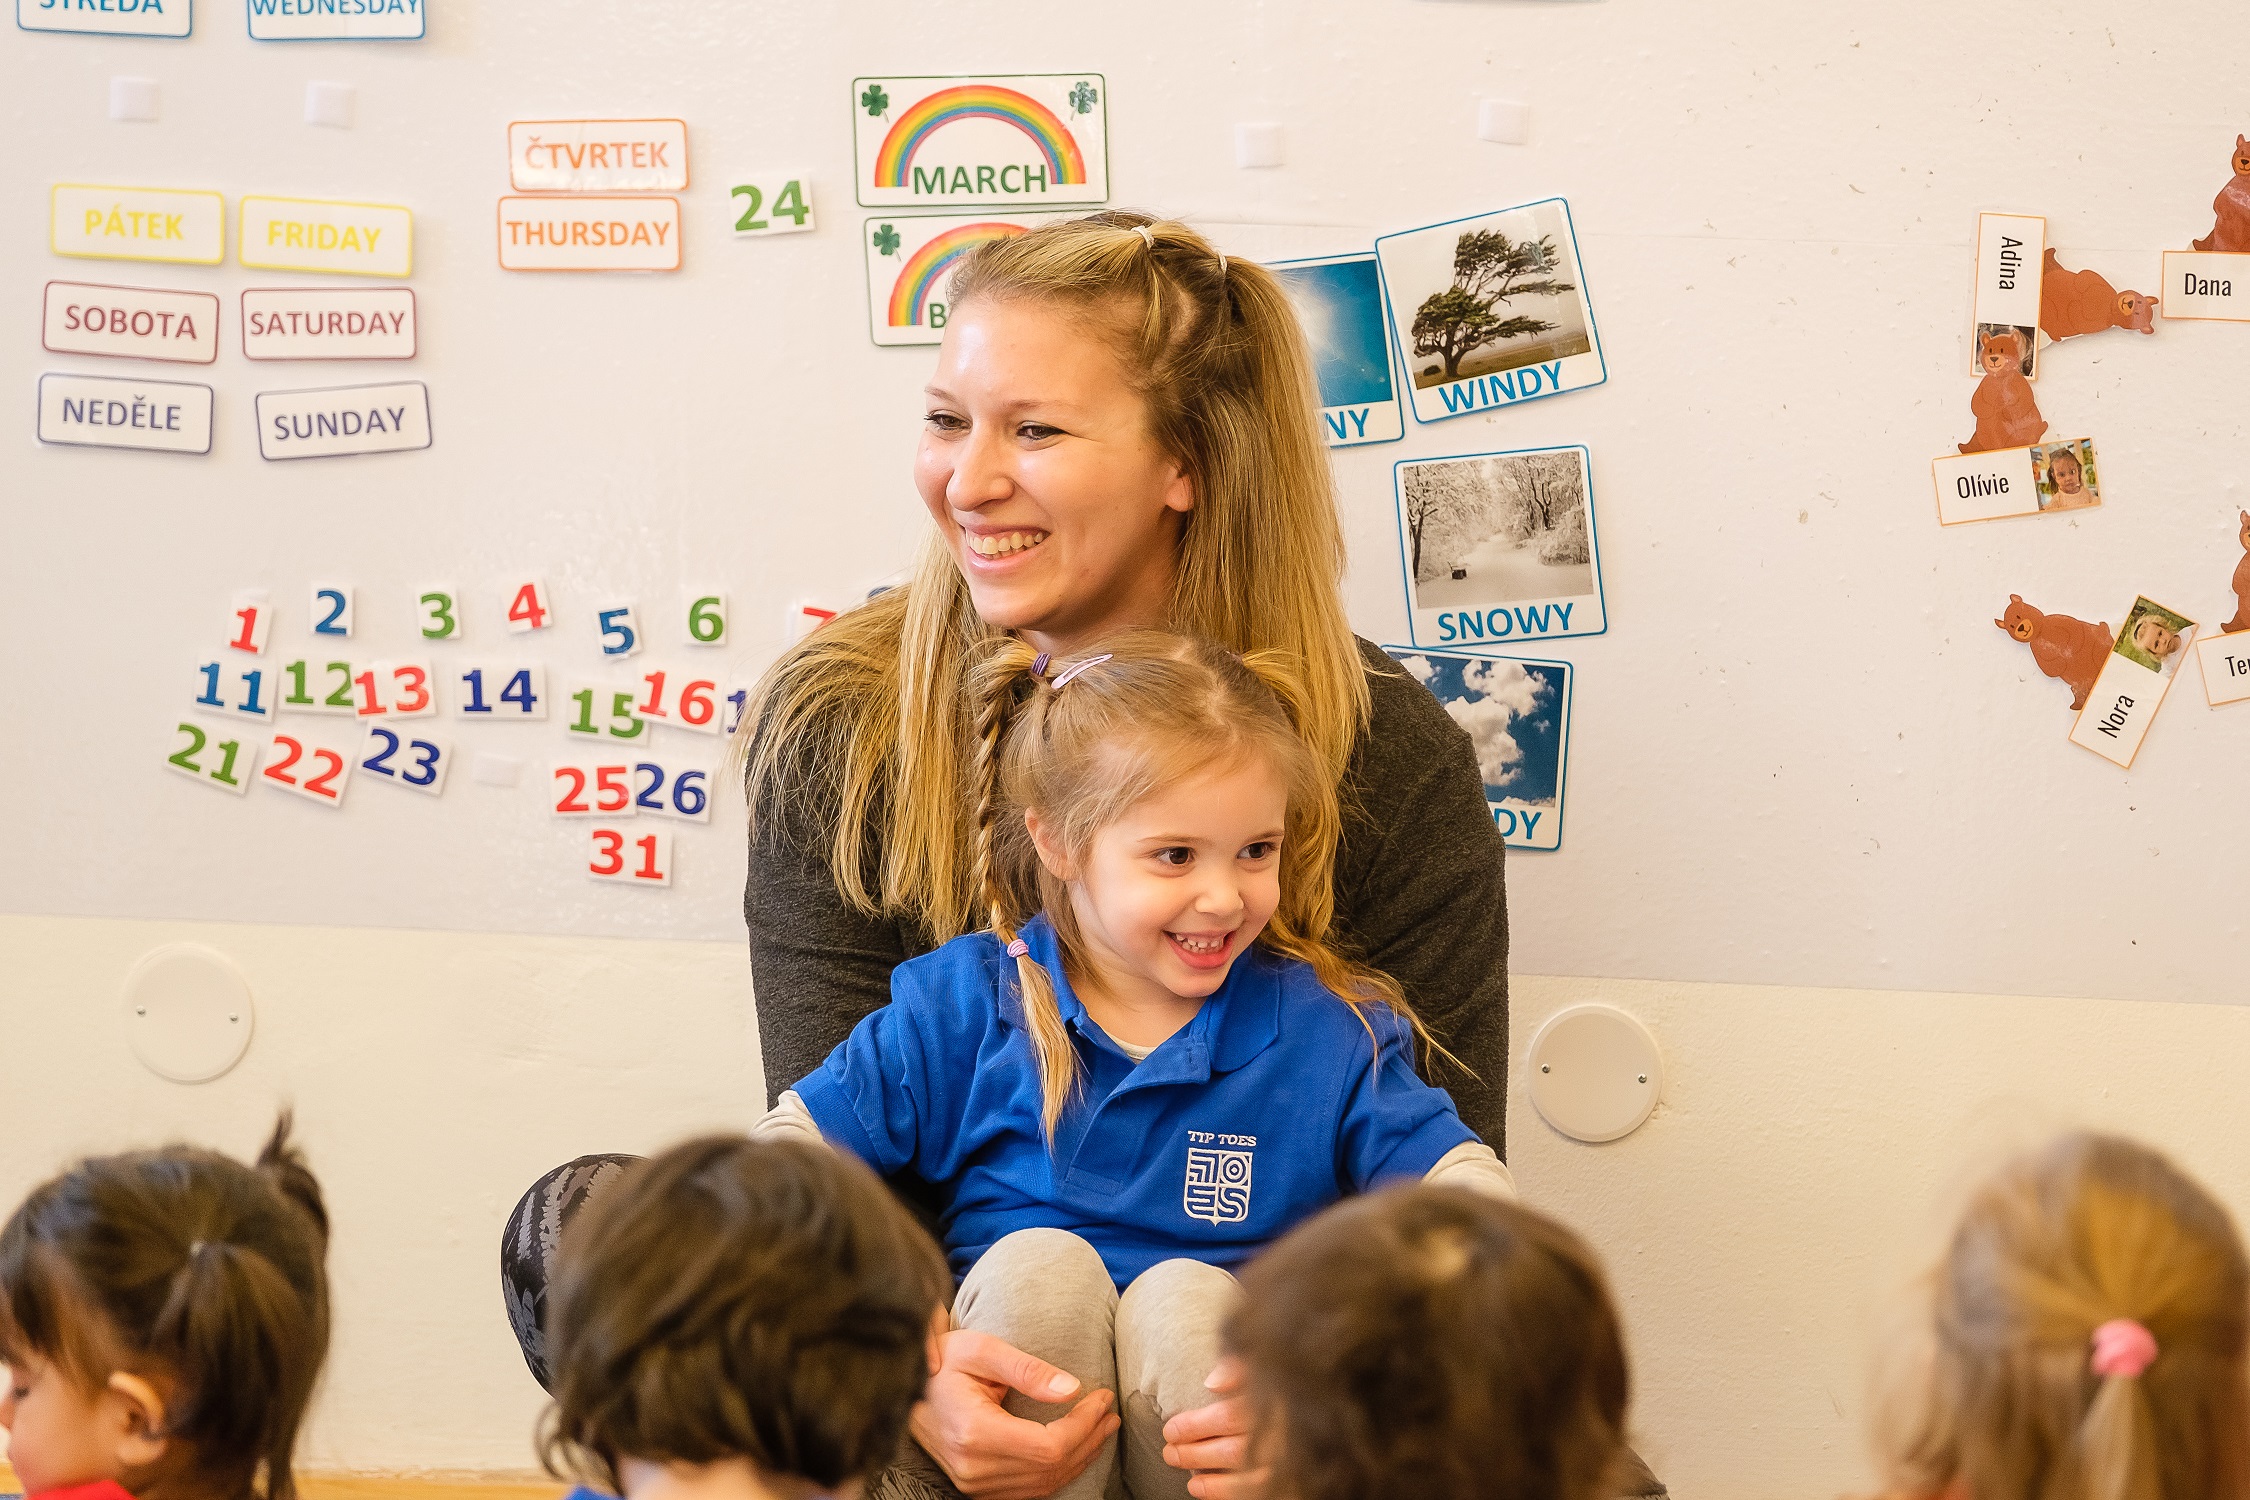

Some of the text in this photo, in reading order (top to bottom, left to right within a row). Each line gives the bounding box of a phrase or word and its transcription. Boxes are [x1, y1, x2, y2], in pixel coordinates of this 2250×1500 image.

[252, 0, 418, 15] WEDNESDAY
[526, 137, 668, 169] ČTVRTEK
[914, 164, 1047, 194] MARCH
[86, 205, 182, 240] PÁTEK
[732, 181, 809, 232] 24
[268, 221, 380, 252] FRIDAY
[506, 221, 669, 246] THURSDAY
[1998, 236, 2023, 290] Adina
[2185, 273, 2231, 296] Dana
[66, 306, 196, 339] SOBOTA
[251, 313, 404, 335] SATURDAY
[1438, 362, 1562, 413] WINDY
[64, 396, 180, 430] NEDĚLE
[275, 408, 404, 440] SUNDAY
[1957, 475, 2009, 498] Olívie
[315, 590, 346, 634] 2
[422, 594, 454, 640] 3
[508, 584, 545, 629] 4
[690, 598, 723, 641] 6
[1438, 602, 1574, 641] SNOWY
[230, 608, 258, 654] 1
[599, 609, 634, 654] 5
[197, 663, 266, 714] 11
[285, 661, 354, 705] 12
[354, 667, 429, 715] 13
[463, 670, 537, 712] 14
[637, 670, 716, 726] 16
[570, 688, 645, 739] 15
[2096, 693, 2135, 739] Nora
[169, 724, 239, 785] 21
[264, 736, 343, 798] 22
[363, 729, 440, 785] 23
[556, 767, 628, 812] 25
[636, 764, 706, 814] 26
[590, 830, 663, 879] 31
[1188, 1131, 1256, 1146] TIP TOES
